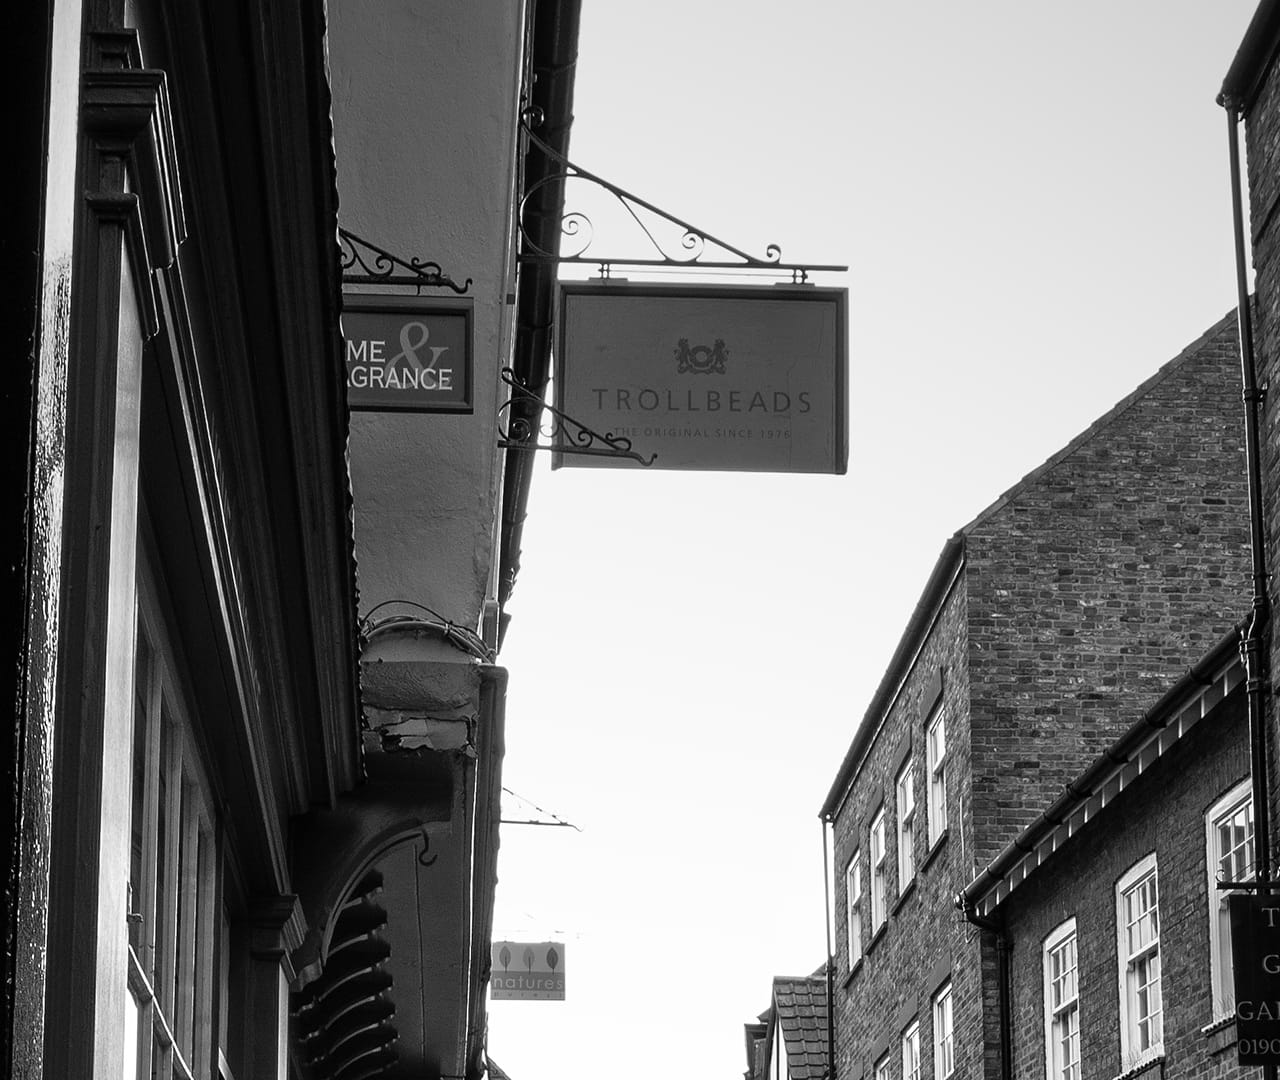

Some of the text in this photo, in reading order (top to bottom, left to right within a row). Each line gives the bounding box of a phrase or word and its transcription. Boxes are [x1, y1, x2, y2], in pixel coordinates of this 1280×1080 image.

[384, 321, 449, 389] &
[346, 366, 453, 391] GRANCE
[592, 389, 811, 413] TROLLBEADS
[614, 427, 791, 439] THE ORIGINAL SINCE 1976
[494, 976, 564, 990] natures
